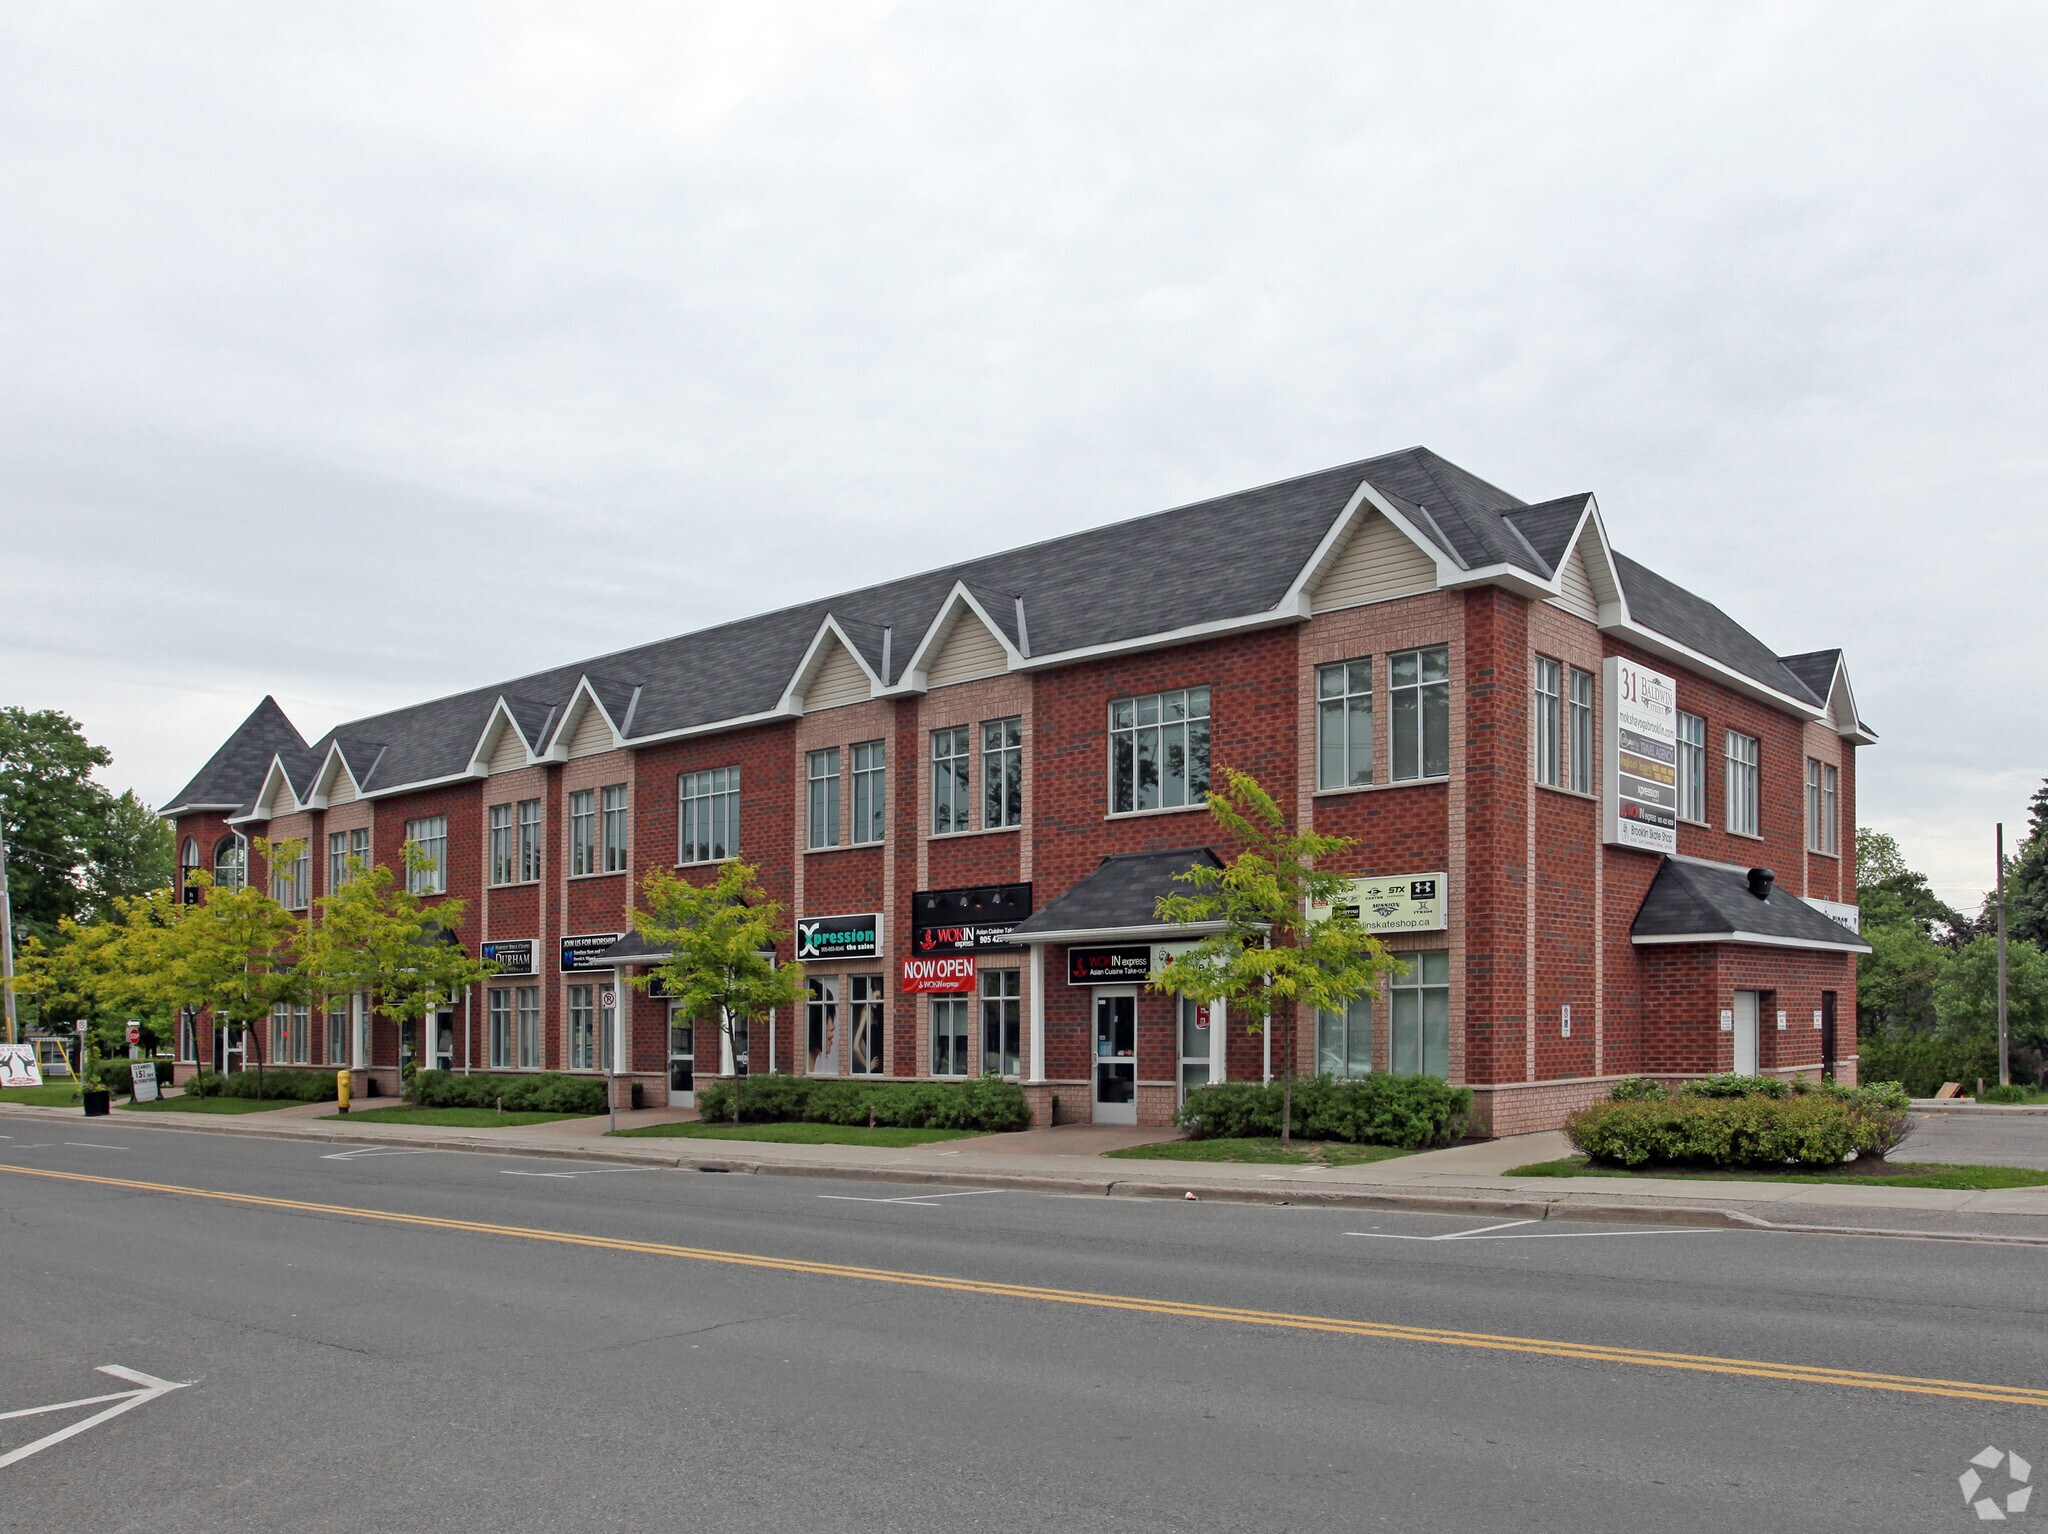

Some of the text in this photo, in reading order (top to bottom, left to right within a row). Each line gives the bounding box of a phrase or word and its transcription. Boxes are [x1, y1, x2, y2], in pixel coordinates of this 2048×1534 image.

[1621, 667, 1638, 703] 31
[1641, 677, 1673, 706] BALDWIN
[1650, 704, 1664, 715] STREET
[1638, 785, 1660, 799] xpression
[1631, 826, 1649, 838] Brooklin
[1649, 829, 1662, 840] Skate
[1662, 832, 1672, 844] Shop
[563, 940, 575, 948] JOIN
[582, 938, 592, 946] FOR
[955, 940, 975, 948] express
[980, 935, 991, 943] 905
[495, 953, 531, 967] DURHAM
[1121, 957, 1147, 967] express
[904, 958, 974, 979] NOW OPEN
[1124, 967, 1147, 975] Take-out
